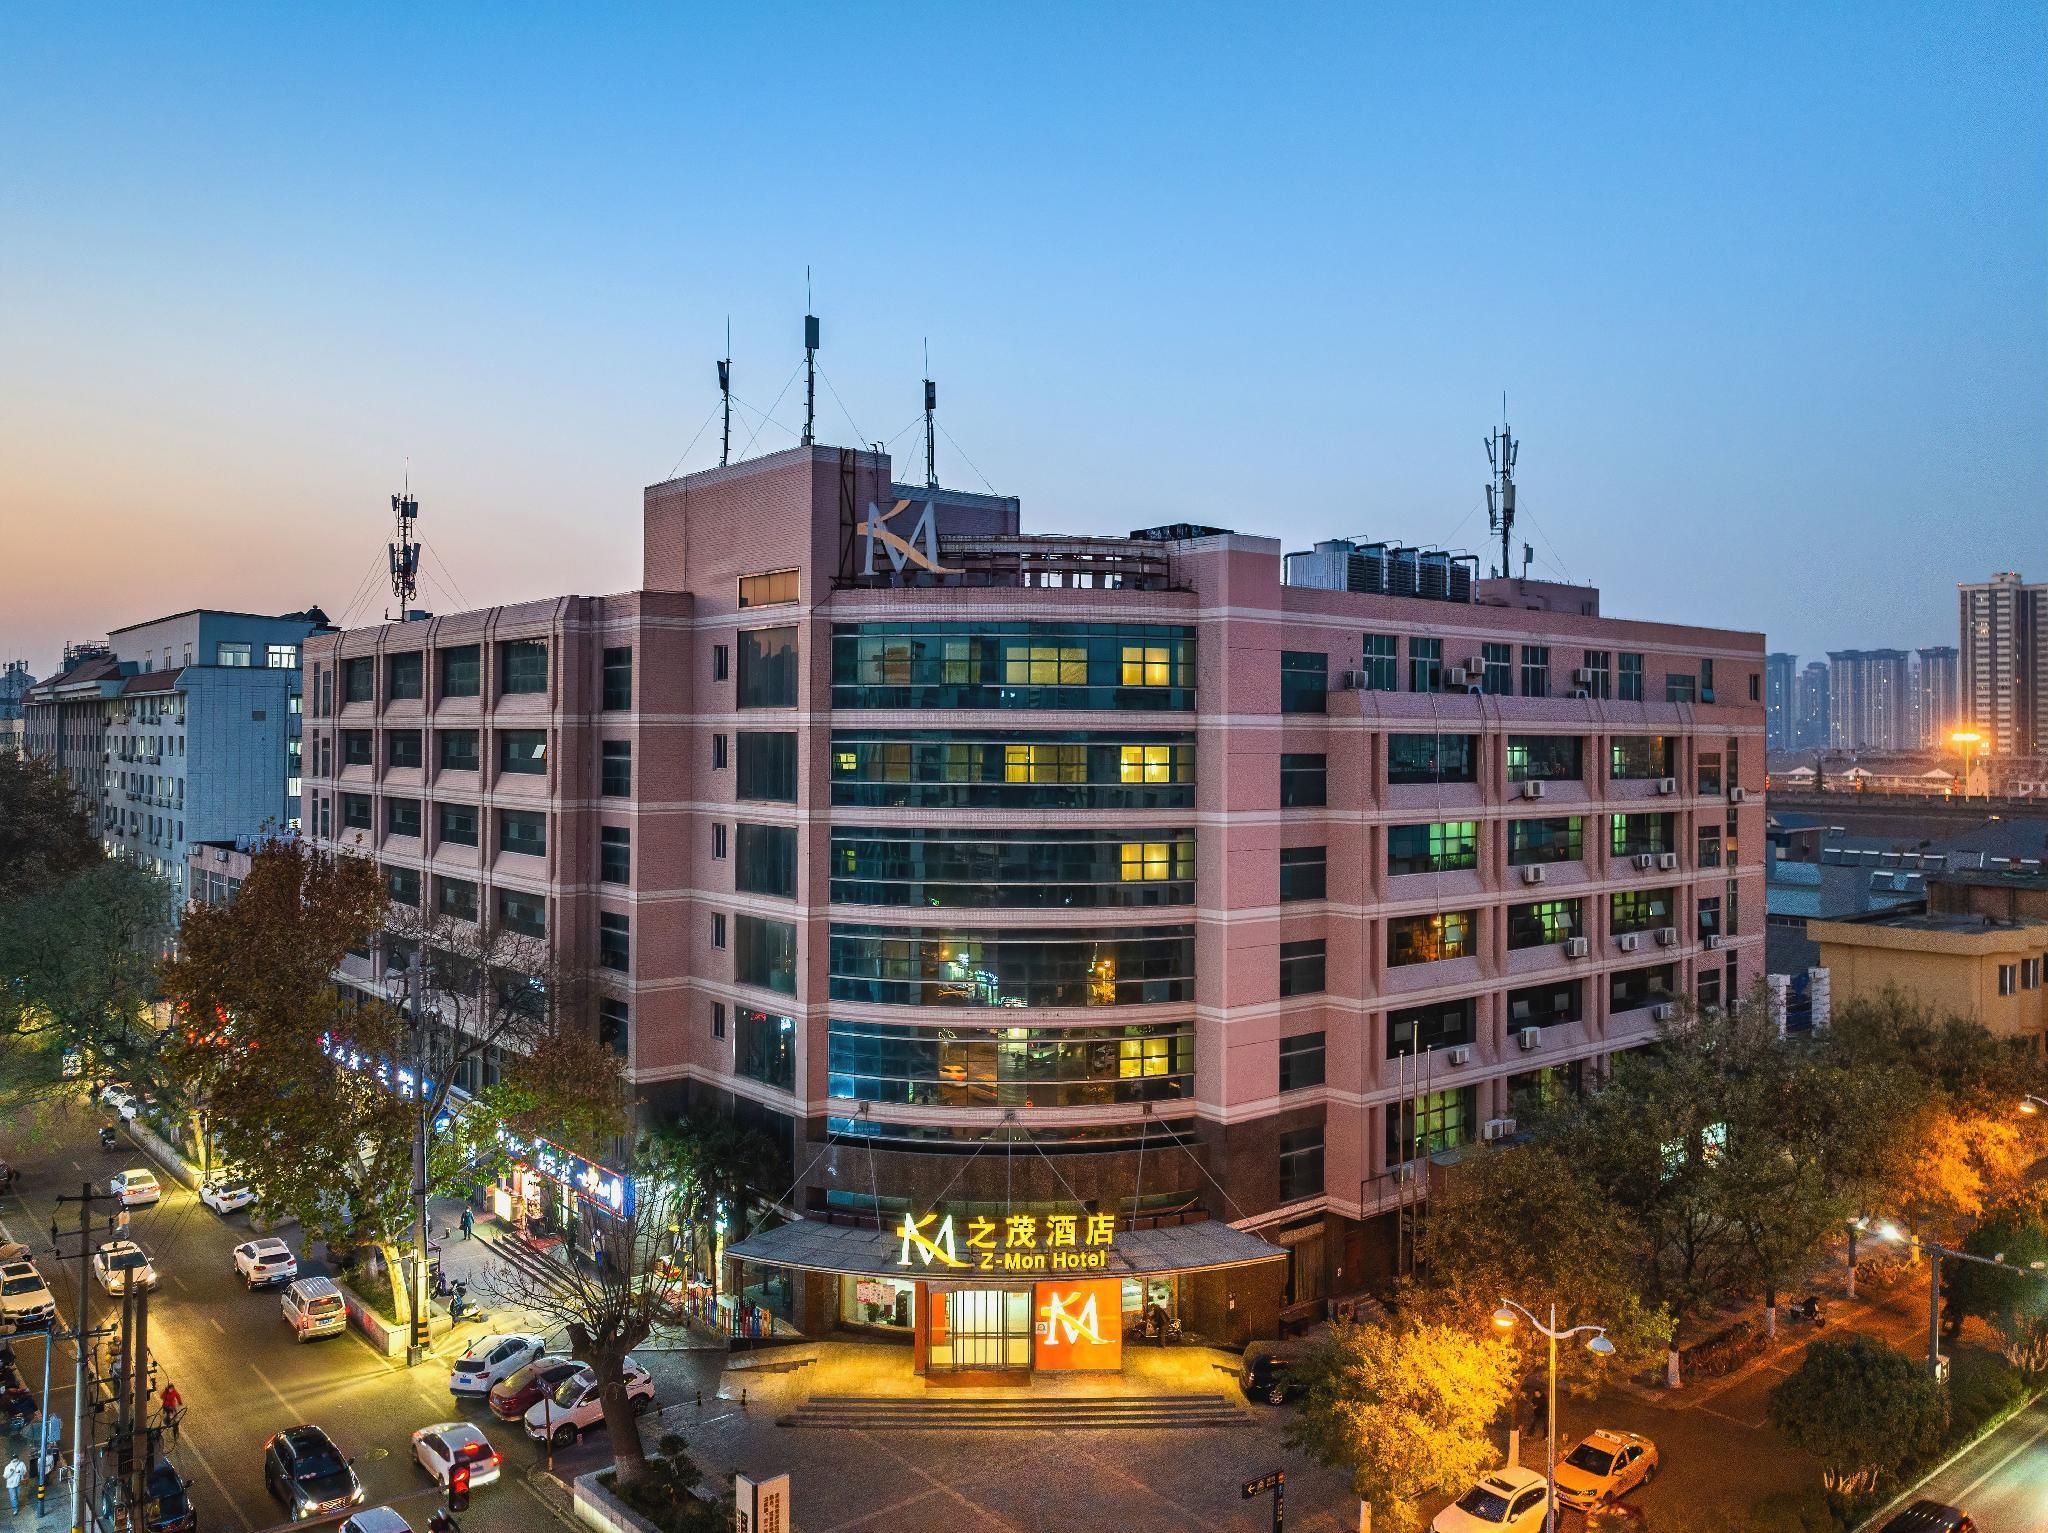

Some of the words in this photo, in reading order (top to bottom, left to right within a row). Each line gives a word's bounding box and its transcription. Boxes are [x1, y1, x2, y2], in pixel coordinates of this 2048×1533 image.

[966, 1212, 1115, 1249] 之茂酒店
[981, 1250, 1045, 1270] Z-Mon
[1053, 1249, 1106, 1269] Hotel
